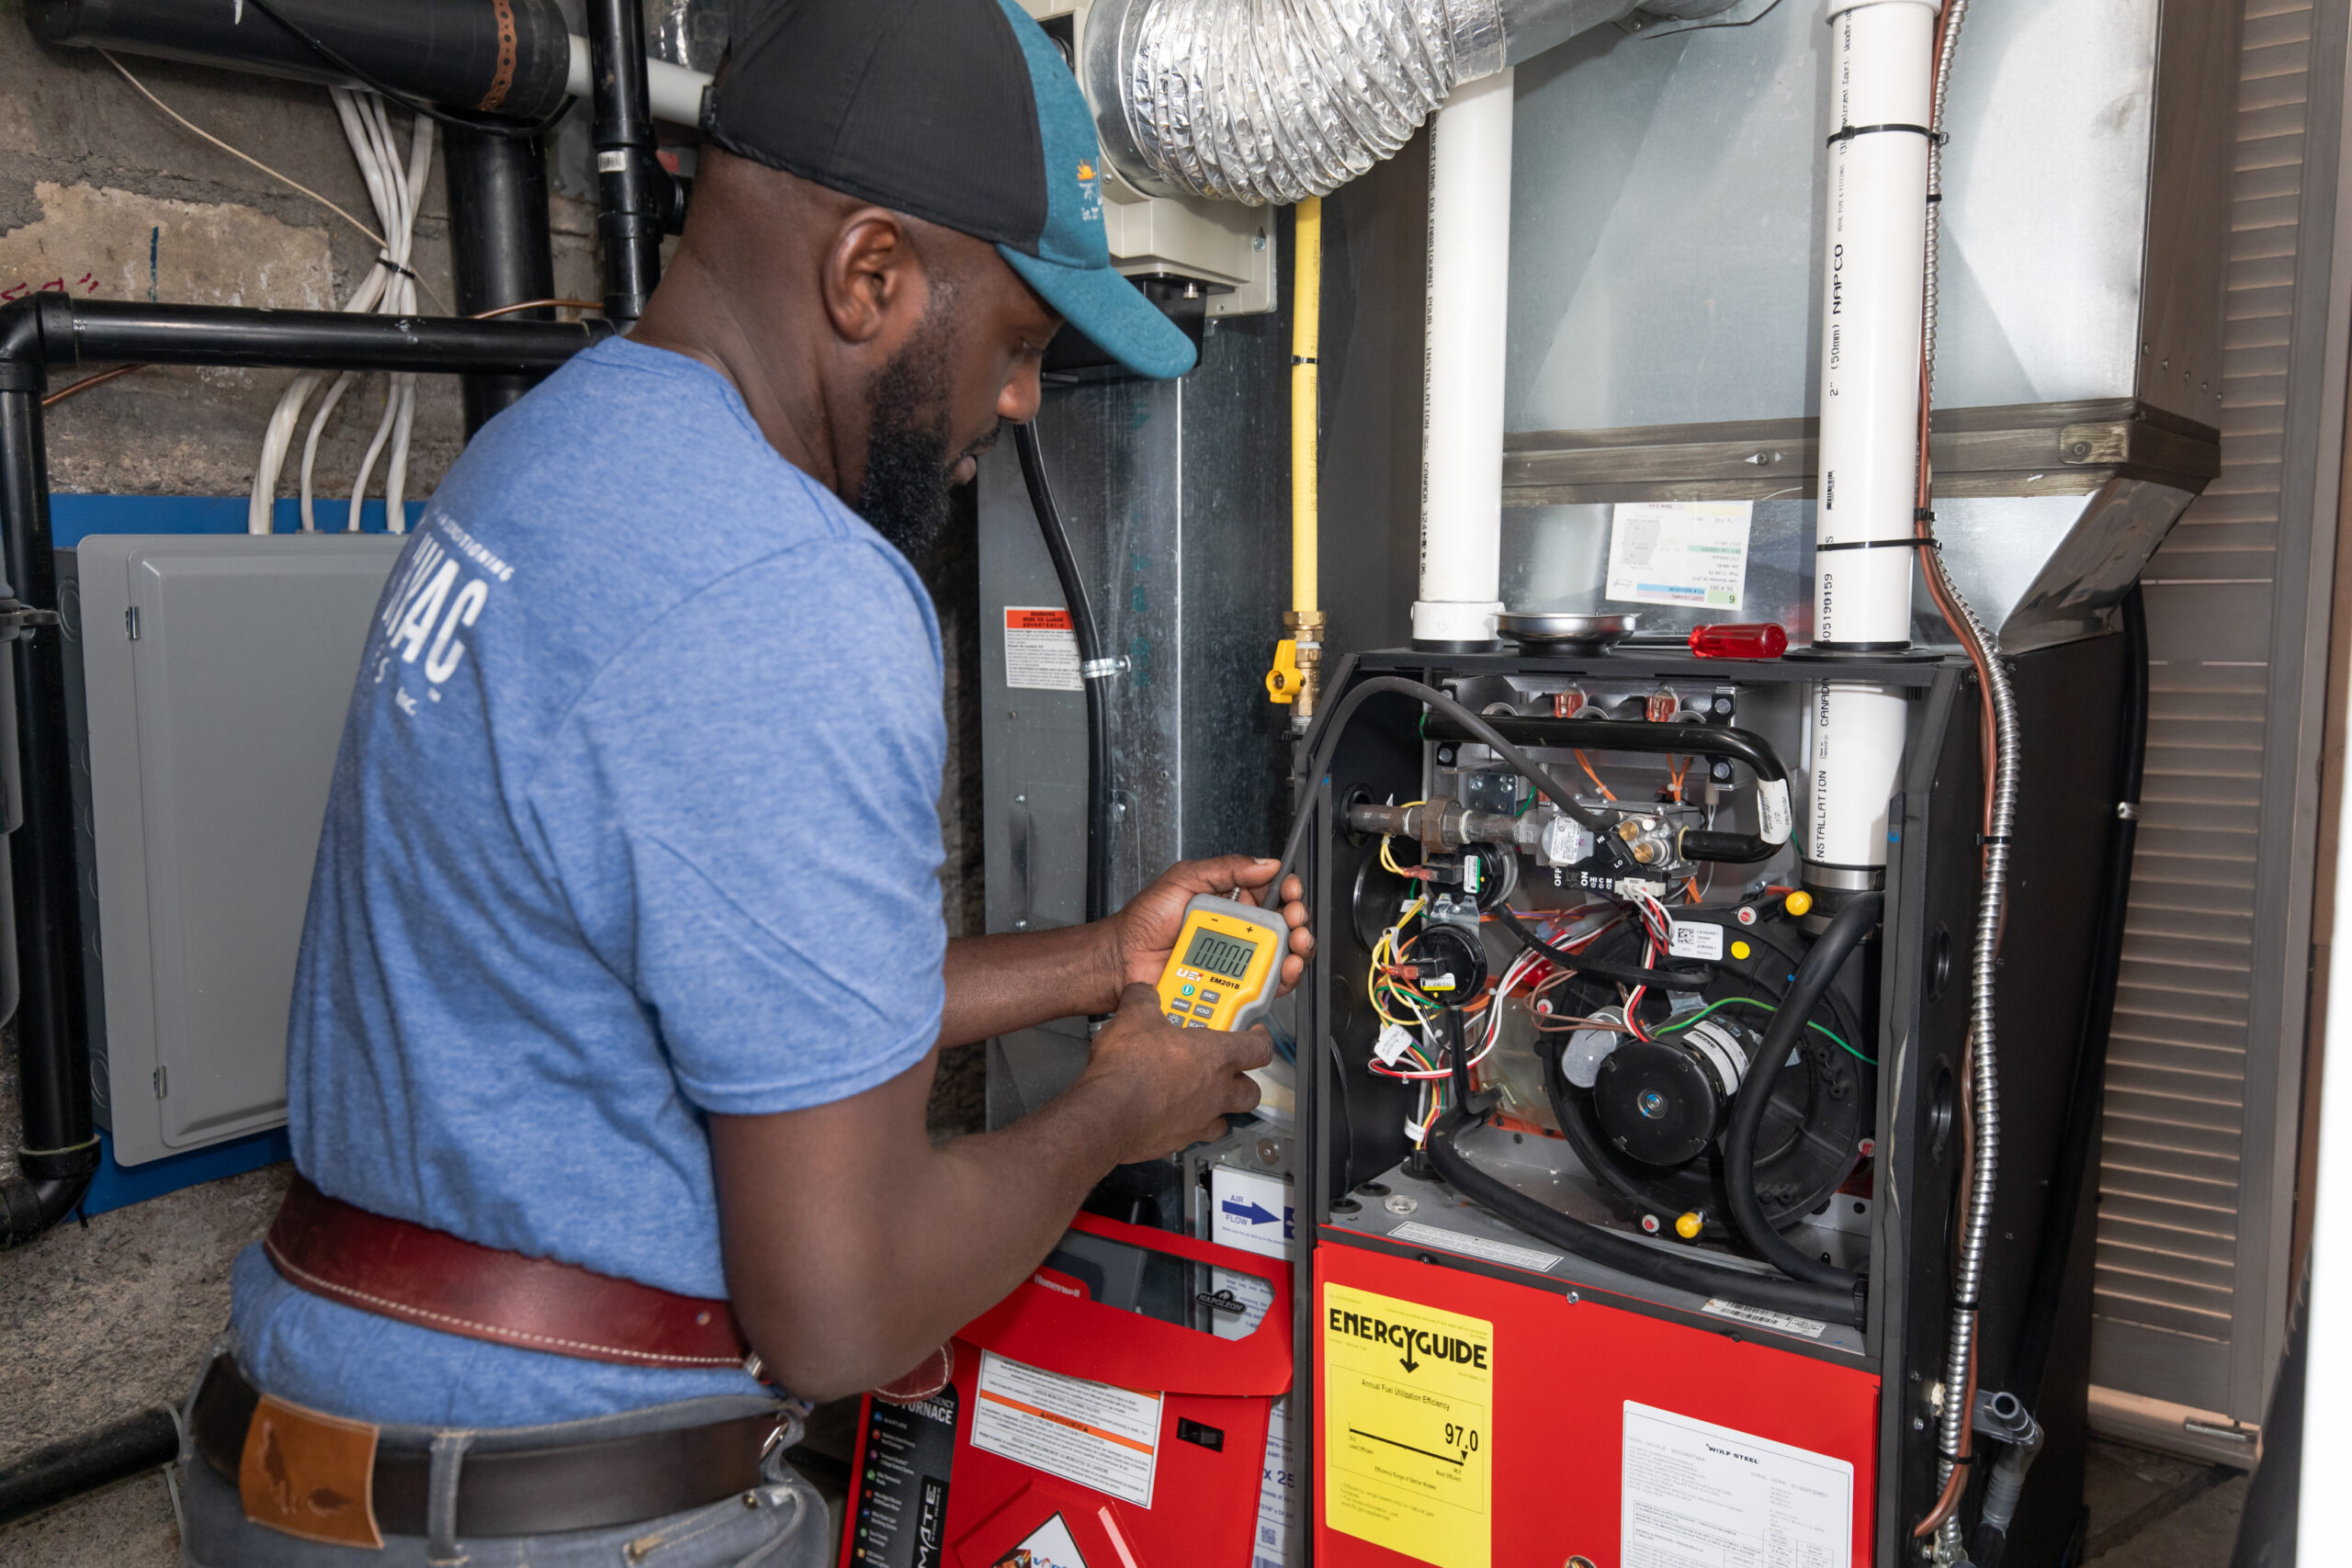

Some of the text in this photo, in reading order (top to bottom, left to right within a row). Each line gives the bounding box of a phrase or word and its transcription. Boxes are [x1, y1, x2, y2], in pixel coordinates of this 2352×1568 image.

[1429, 112, 1437, 191] NSTRUCTIONS
[1429, 197, 1435, 212] DU
[1427, 218, 1435, 289] FABRIQUANT
[1833, 244, 1843, 314] NAPCO
[1831, 324, 1840, 369] (50mm)
[1729, 595, 1735, 603] 6
[1820, 678, 1830, 726] CANADA
[1596, 835, 1605, 844] HI
[1614, 860, 1623, 868] LO
[1581, 871, 1588, 886] ON
[1192, 937, 1254, 978] 0000
[1210, 977, 1240, 990] EM201B
[1203, 991, 1215, 999] ZERO
[1230, 1195, 1244, 1204] AIR
[1226, 1214, 1248, 1226] FLOW
[1034, 1273, 1080, 1298] Honeywell
[1198, 1294, 1243, 1312] NAPOLEON
[1329, 1307, 1487, 1370] ENERGYGUIDE
[1362, 1378, 1450, 1411] Annual Fuel Utilization Efficiency
[1445, 1422, 1478, 1452] 97.0
[1706, 1443, 1759, 1464] WOLF STEEL
[1264, 1468, 1272, 1481] x
